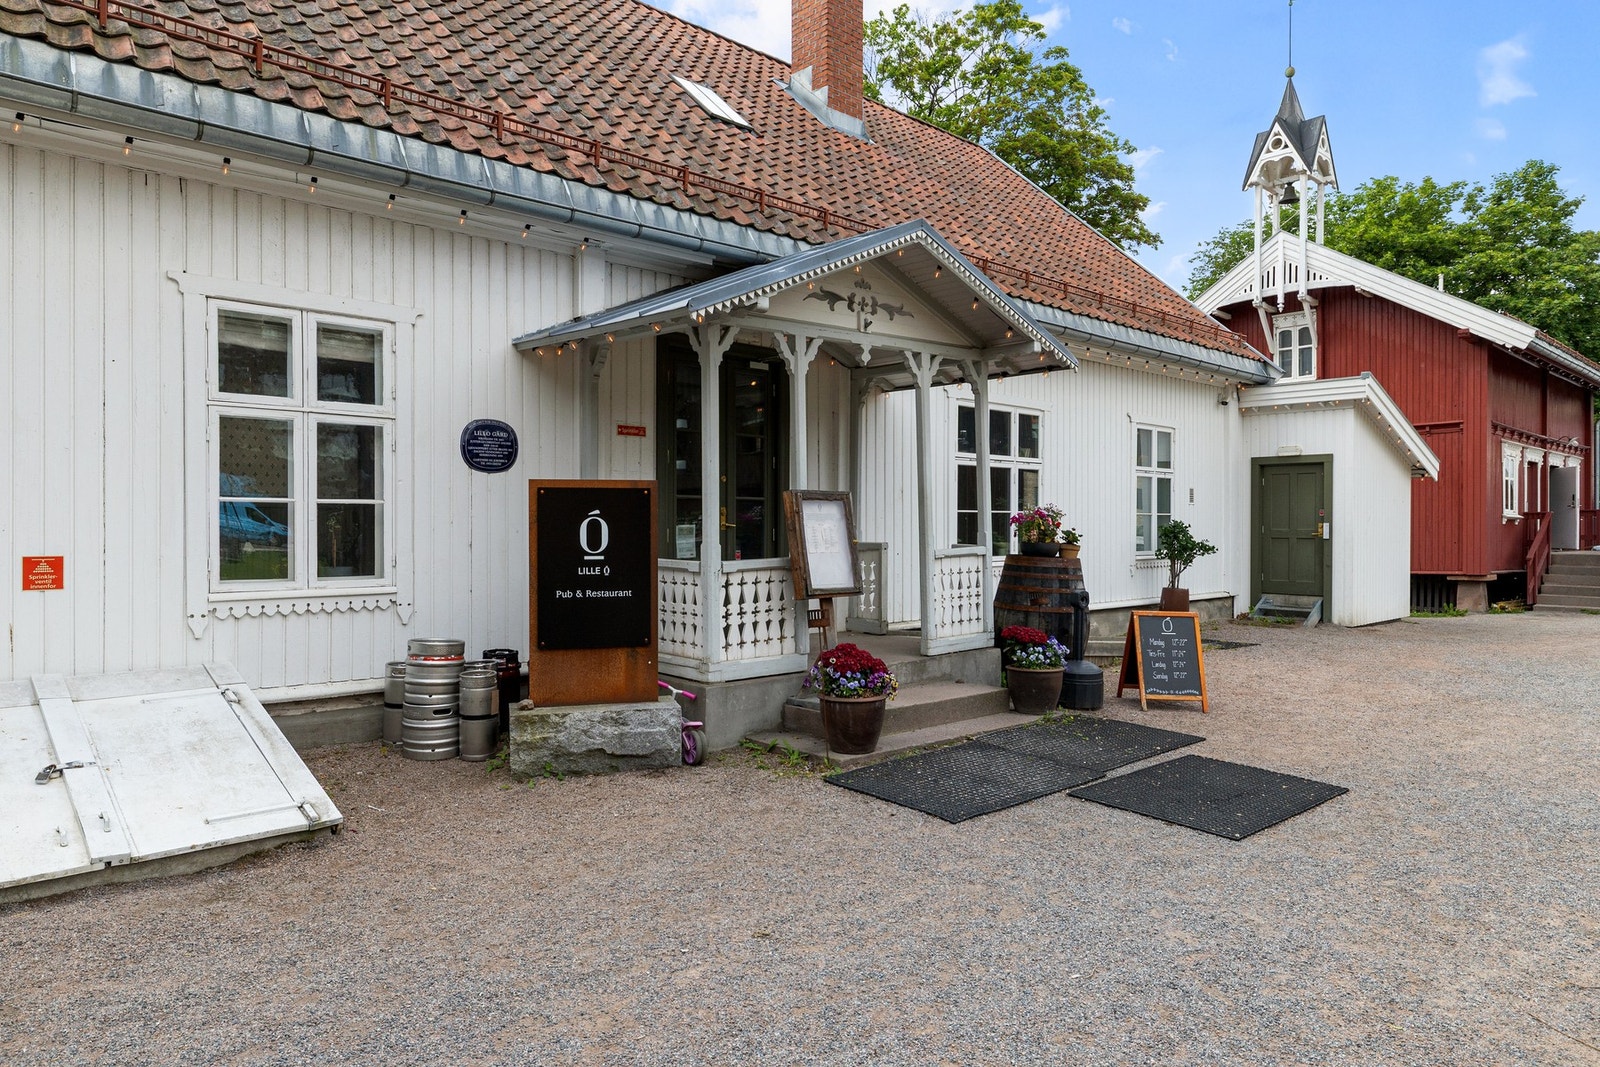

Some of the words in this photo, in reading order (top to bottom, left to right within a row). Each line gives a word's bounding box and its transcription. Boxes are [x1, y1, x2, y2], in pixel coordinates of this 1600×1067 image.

[578, 566, 601, 575] LILLE
[556, 590, 573, 598] Pub
[575, 589, 584, 598] &
[586, 589, 632, 598] Restaurant
